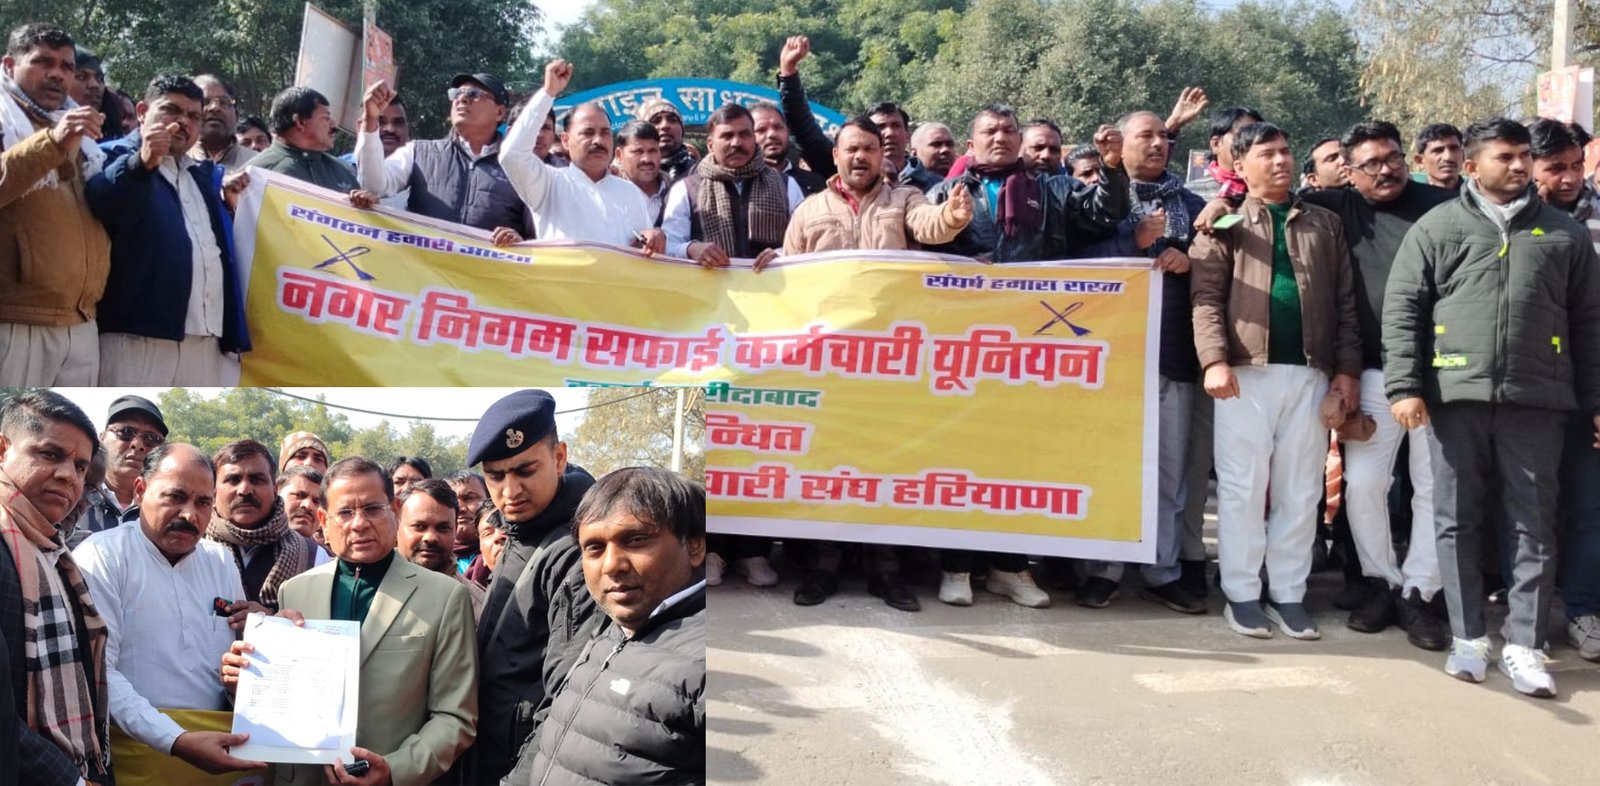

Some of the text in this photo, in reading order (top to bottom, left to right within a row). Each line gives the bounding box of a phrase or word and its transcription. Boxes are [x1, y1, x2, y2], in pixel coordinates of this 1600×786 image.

[386, 230, 455, 253] हमारी
[926, 273, 985, 289] संघर्ष
[990, 278, 1059, 291] हमारा
[281, 271, 1103, 391] नगर निगम सफाई कर्मचारी यूनियन
[800, 471, 883, 503] संघ
[892, 473, 1083, 515] हरियाणा
